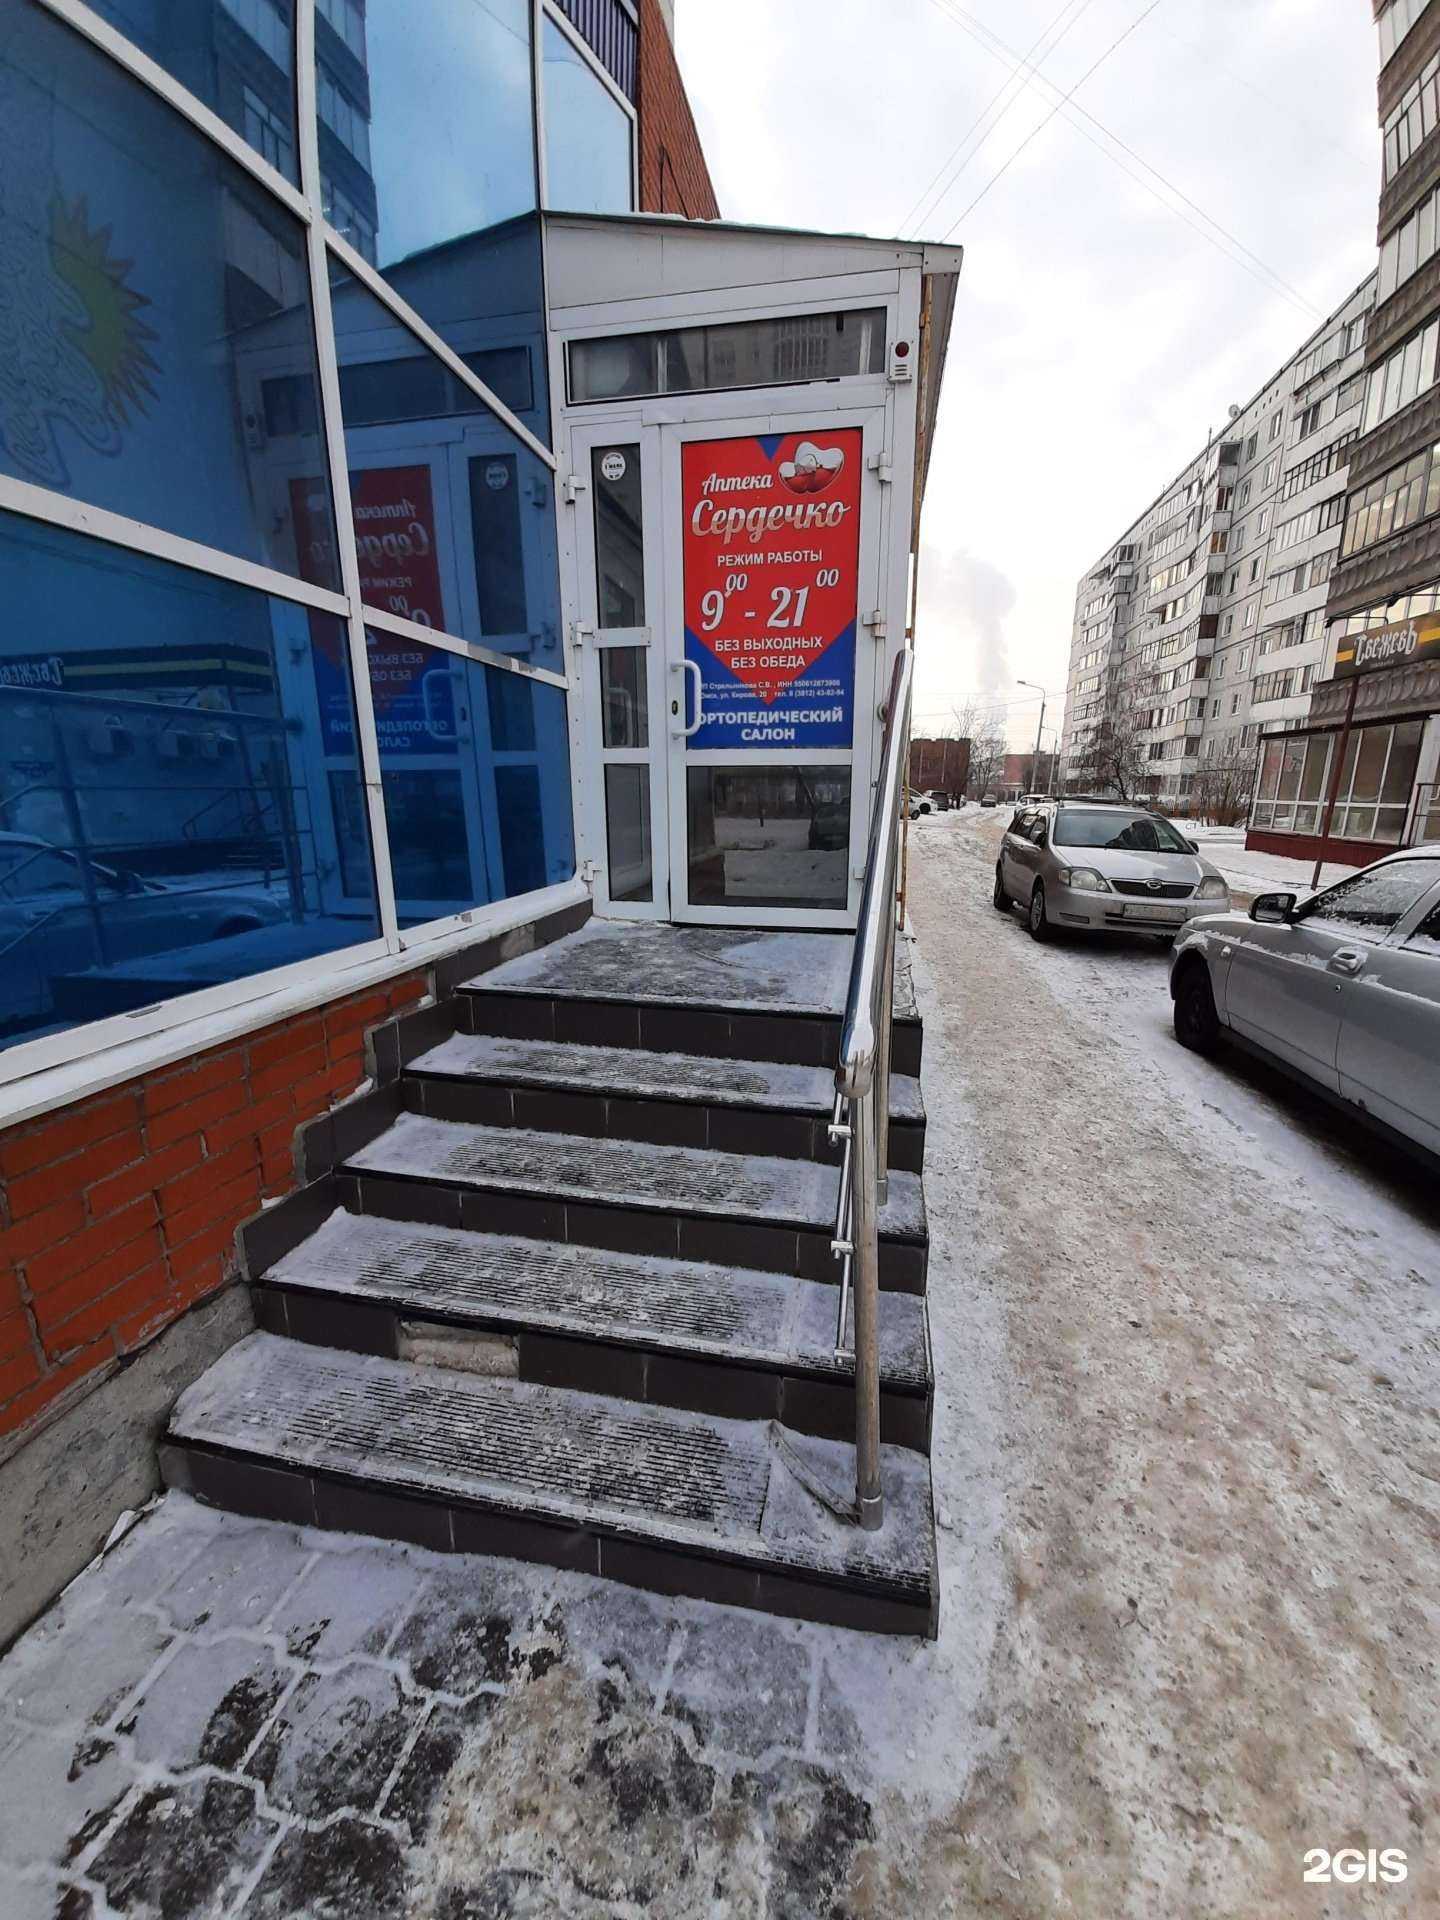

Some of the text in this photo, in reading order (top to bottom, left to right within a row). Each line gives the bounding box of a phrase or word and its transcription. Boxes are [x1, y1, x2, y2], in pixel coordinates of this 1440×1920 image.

[702, 472, 774, 495] Аптека
[692, 499, 852, 545] Сердечко
[717, 549, 823, 567] РЕЖИМ РАБОТЫ
[766, 586, 810, 629] 21
[715, 635, 823, 652] БЕЗ ВЫХОДНЫХ
[731, 654, 806, 669] БЕЗ ОБЕДА
[776, 679, 793, 688] ИНН
[741, 728, 796, 741] САЛОН
